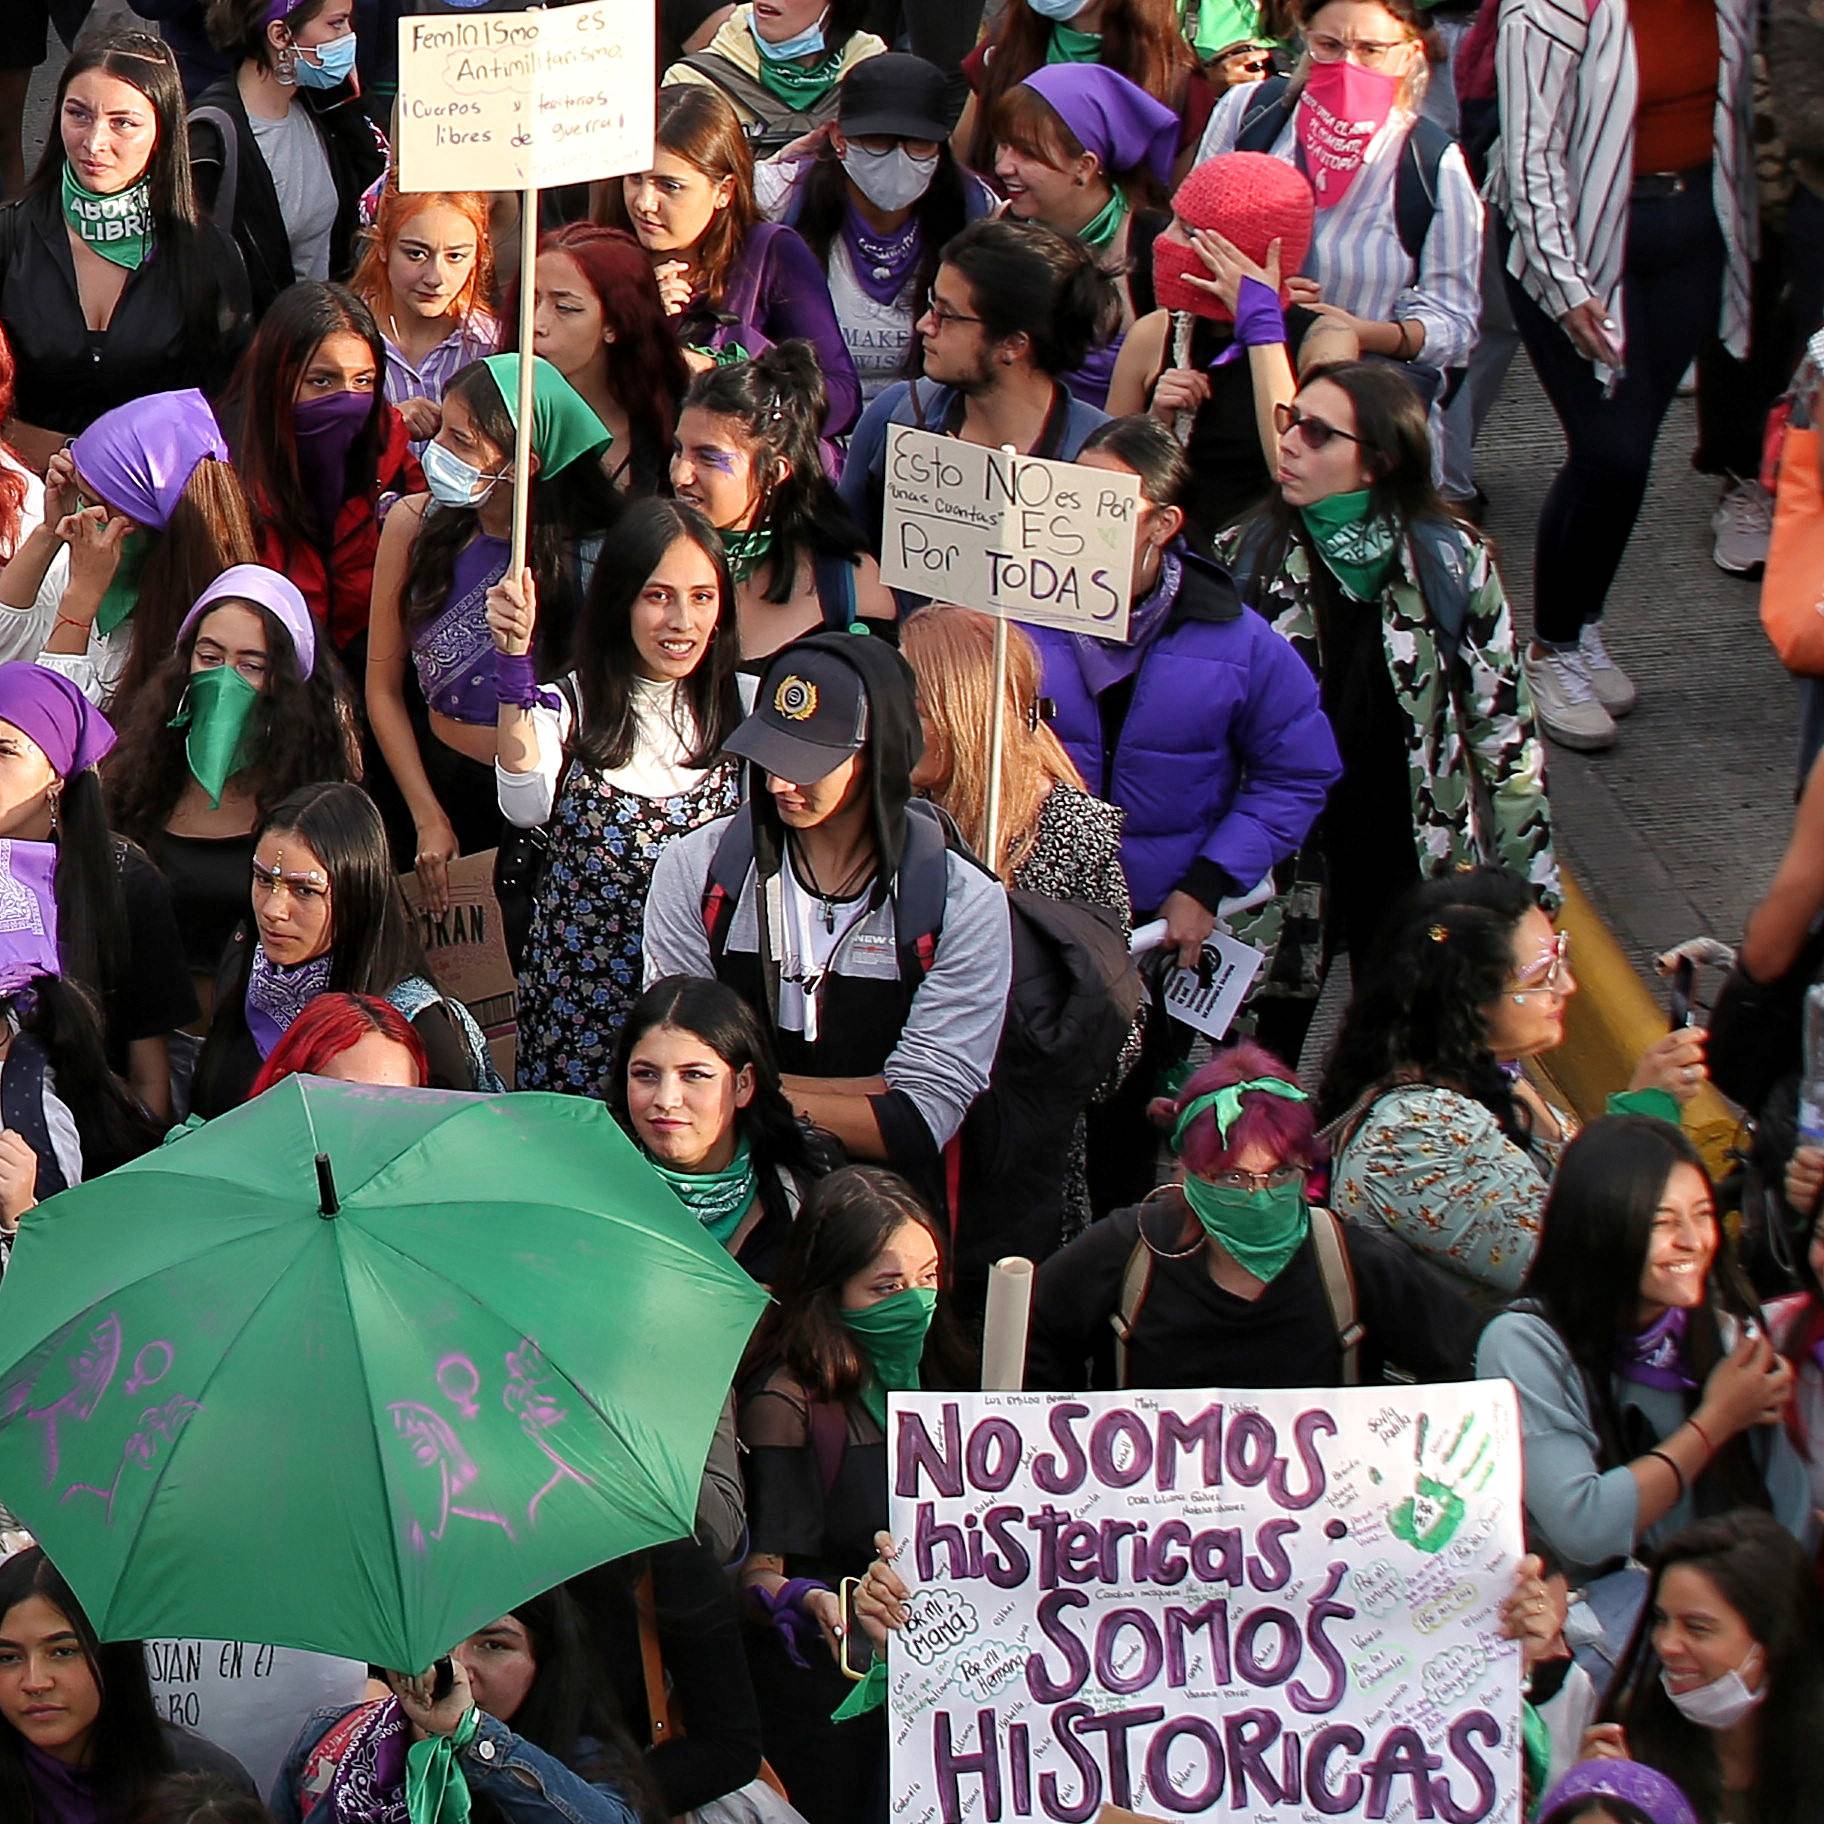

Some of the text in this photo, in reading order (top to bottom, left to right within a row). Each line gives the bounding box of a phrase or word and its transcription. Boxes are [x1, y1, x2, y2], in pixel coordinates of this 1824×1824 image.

[436, 124, 533, 148] libres de
[893, 430, 963, 489] Esto
[984, 453, 1054, 507] NO
[1054, 491, 1081, 509] es
[900, 521, 960, 571] Por
[1021, 510, 1086, 556] ES
[1031, 1400, 1340, 1510] SOMOS
[1026, 1588, 1354, 1712] SOMOS
